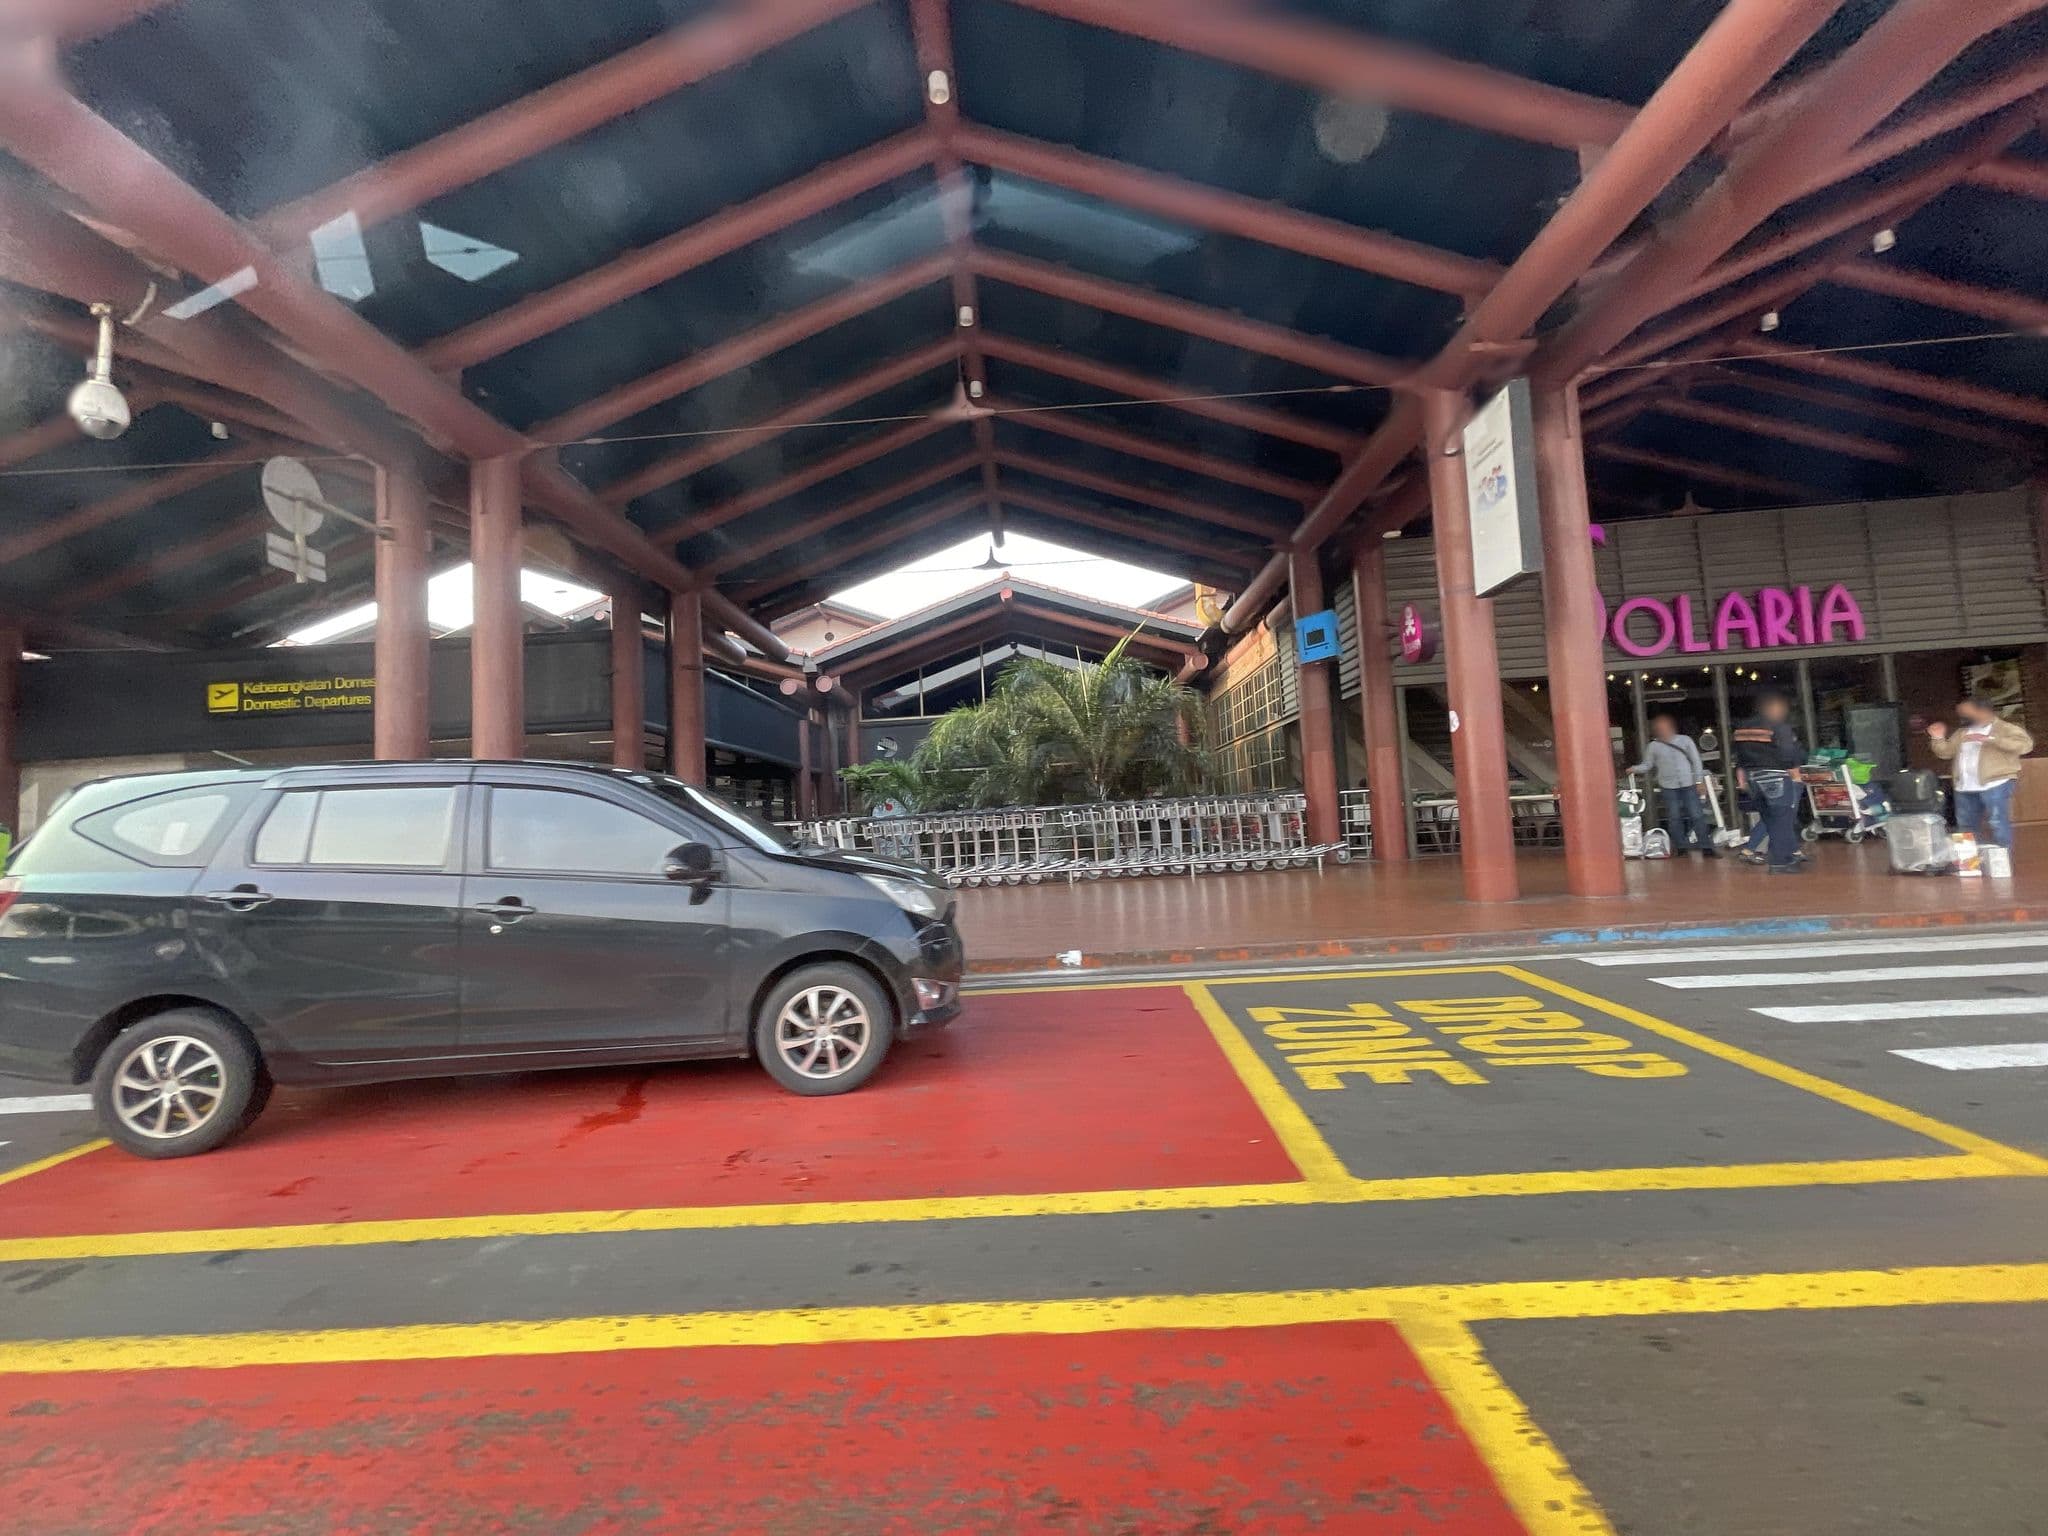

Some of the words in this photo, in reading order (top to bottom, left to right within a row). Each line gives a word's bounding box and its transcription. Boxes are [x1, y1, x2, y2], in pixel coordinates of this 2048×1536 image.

[1594, 582, 1866, 657] OLARIA
[243, 697, 301, 711] Domestic
[304, 694, 372, 710] Departures
[1246, 1002, 1490, 1090] ZONE
[1393, 996, 1689, 1078] DROP
